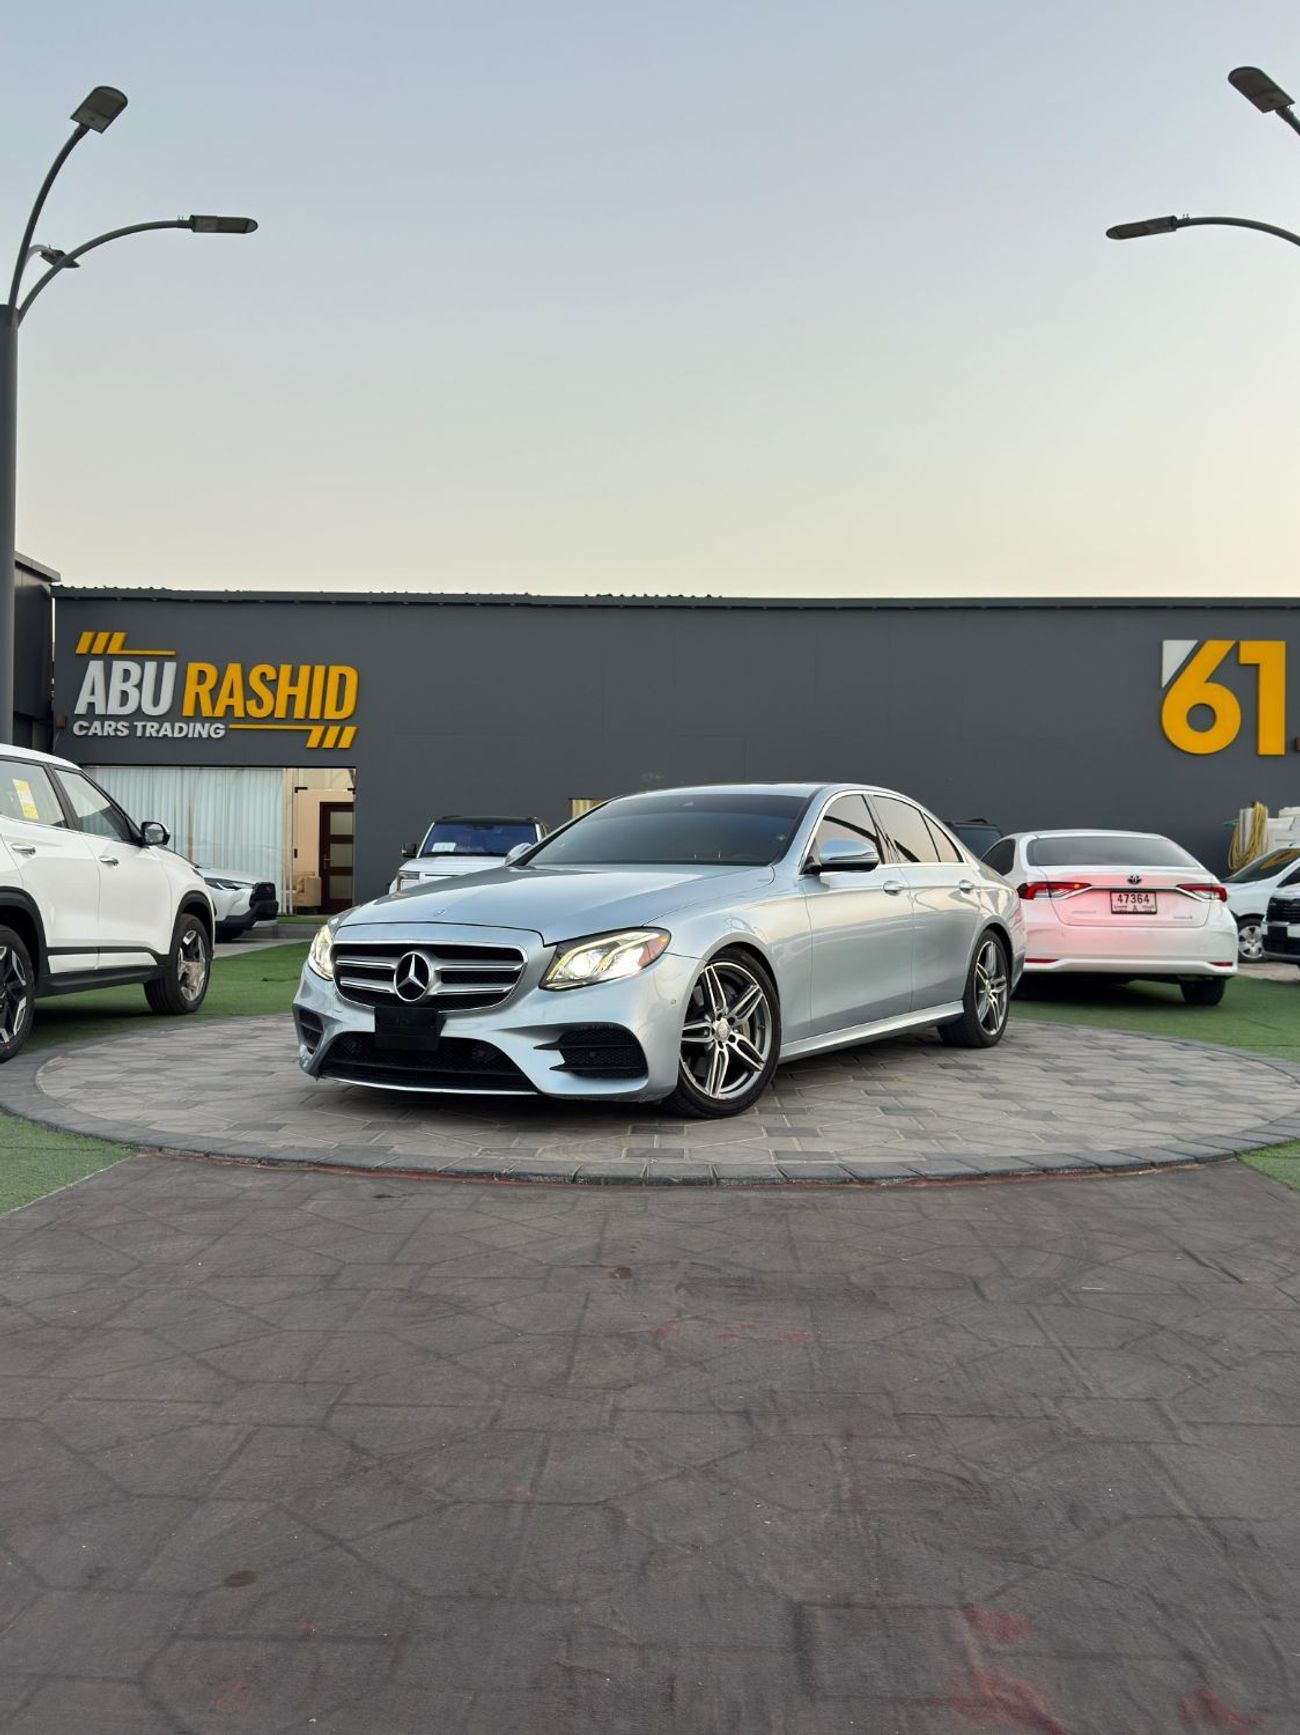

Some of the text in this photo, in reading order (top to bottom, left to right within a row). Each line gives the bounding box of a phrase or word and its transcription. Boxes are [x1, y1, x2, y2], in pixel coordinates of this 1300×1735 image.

[74, 660, 359, 720] ABU RASHID
[1161, 639, 1286, 756] 61
[72, 720, 226, 739] CARS TRADING
[1117, 893, 1149, 904] 47364
